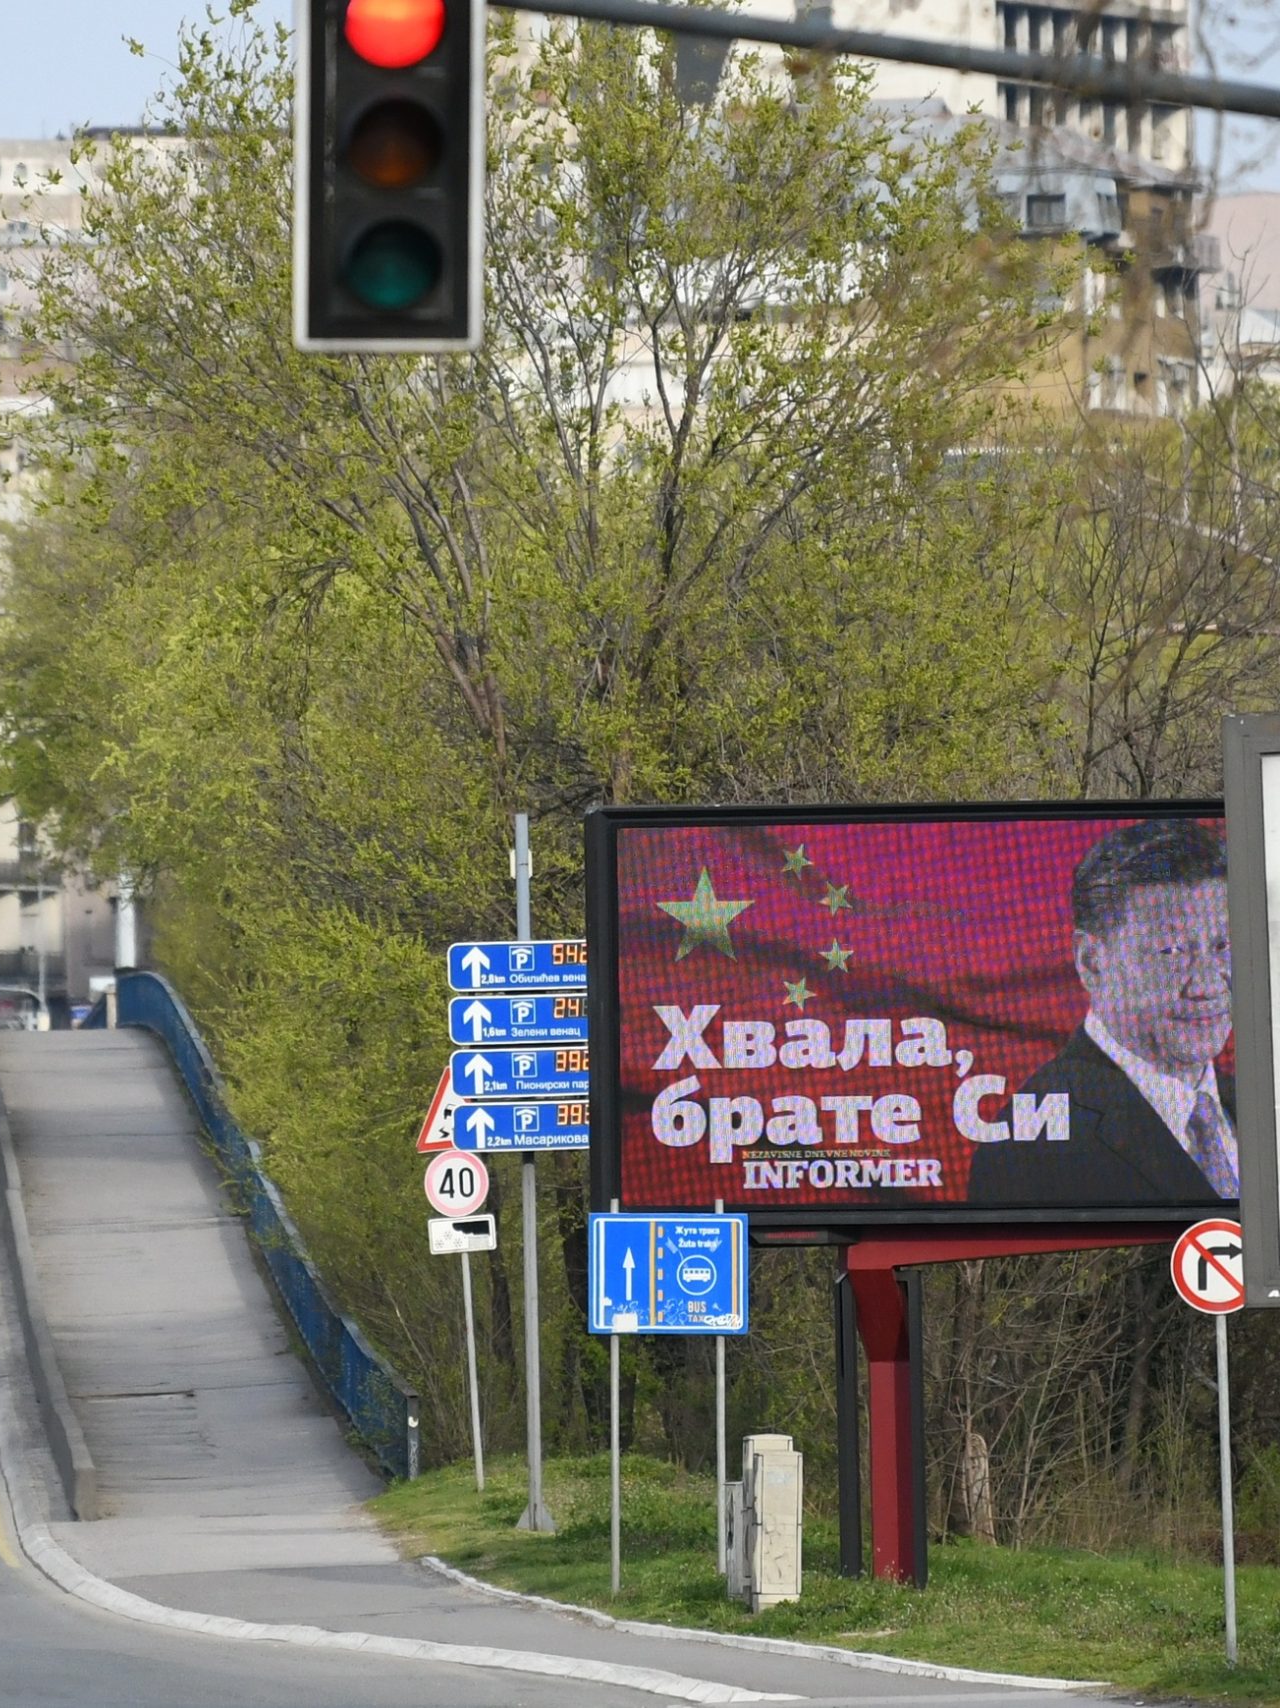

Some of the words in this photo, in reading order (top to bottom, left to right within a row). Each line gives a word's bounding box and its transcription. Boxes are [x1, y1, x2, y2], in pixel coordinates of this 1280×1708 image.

[509, 972, 560, 983] Обилићев
[511, 1026, 548, 1037] Зелени
[550, 1026, 581, 1037] венац
[651, 1004, 975, 1078] Хвала,
[516, 1079, 570, 1091] Пионирски
[651, 1074, 922, 1164] брате
[952, 1073, 1070, 1143] Си
[514, 1133, 589, 1146] Масарикова
[742, 1150, 803, 1160] NEZAVISNE
[805, 1150, 849, 1159] DNEVNE
[849, 1149, 891, 1159] NOVINE
[743, 1159, 943, 1189] INFORMER
[439, 1167, 475, 1199] 40
[675, 1226, 697, 1236] Жута
[678, 1237, 696, 1248] Žuta
[688, 1301, 706, 1312] BUS
